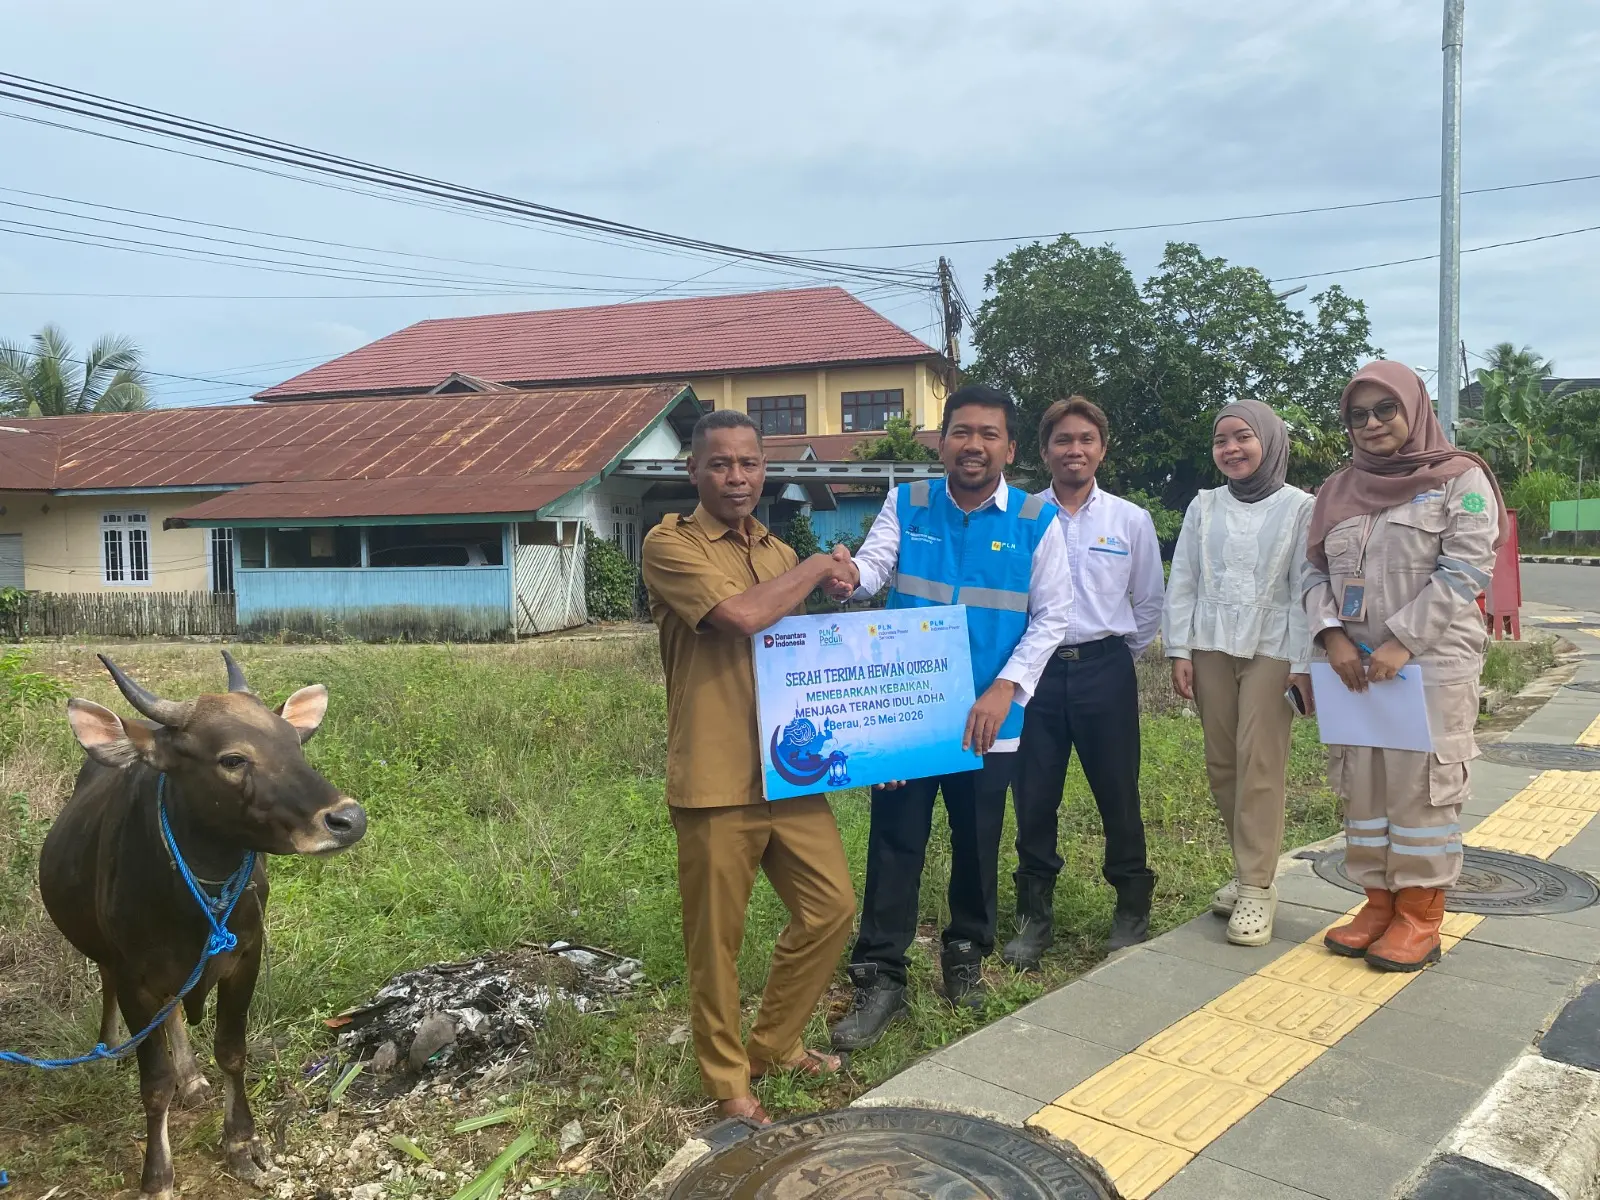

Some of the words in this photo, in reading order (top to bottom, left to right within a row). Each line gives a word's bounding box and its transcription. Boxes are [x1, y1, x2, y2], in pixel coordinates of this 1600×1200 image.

[775, 632, 807, 641] Danantara
[775, 639, 806, 648] Indonesia
[820, 632, 843, 644] Peduli
[785, 669, 823, 687] SERAH
[823, 666, 865, 683] TERIMA
[867, 662, 905, 679] HEWAN
[907, 658, 948, 675] QURBAN
[806, 687, 878, 703] MENEBARKAN
[880, 680, 933, 696] KEBAIKAN,
[795, 703, 847, 719] MENJAGA
[849, 699, 891, 712] TERANG
[892, 696, 915, 707] IDUL
[917, 693, 945, 705] ADHA
[829, 719, 862, 731] Berau,
[863, 716, 877, 727] 25
[878, 713, 897, 725] Mei
[898, 711, 924, 722] 2026
